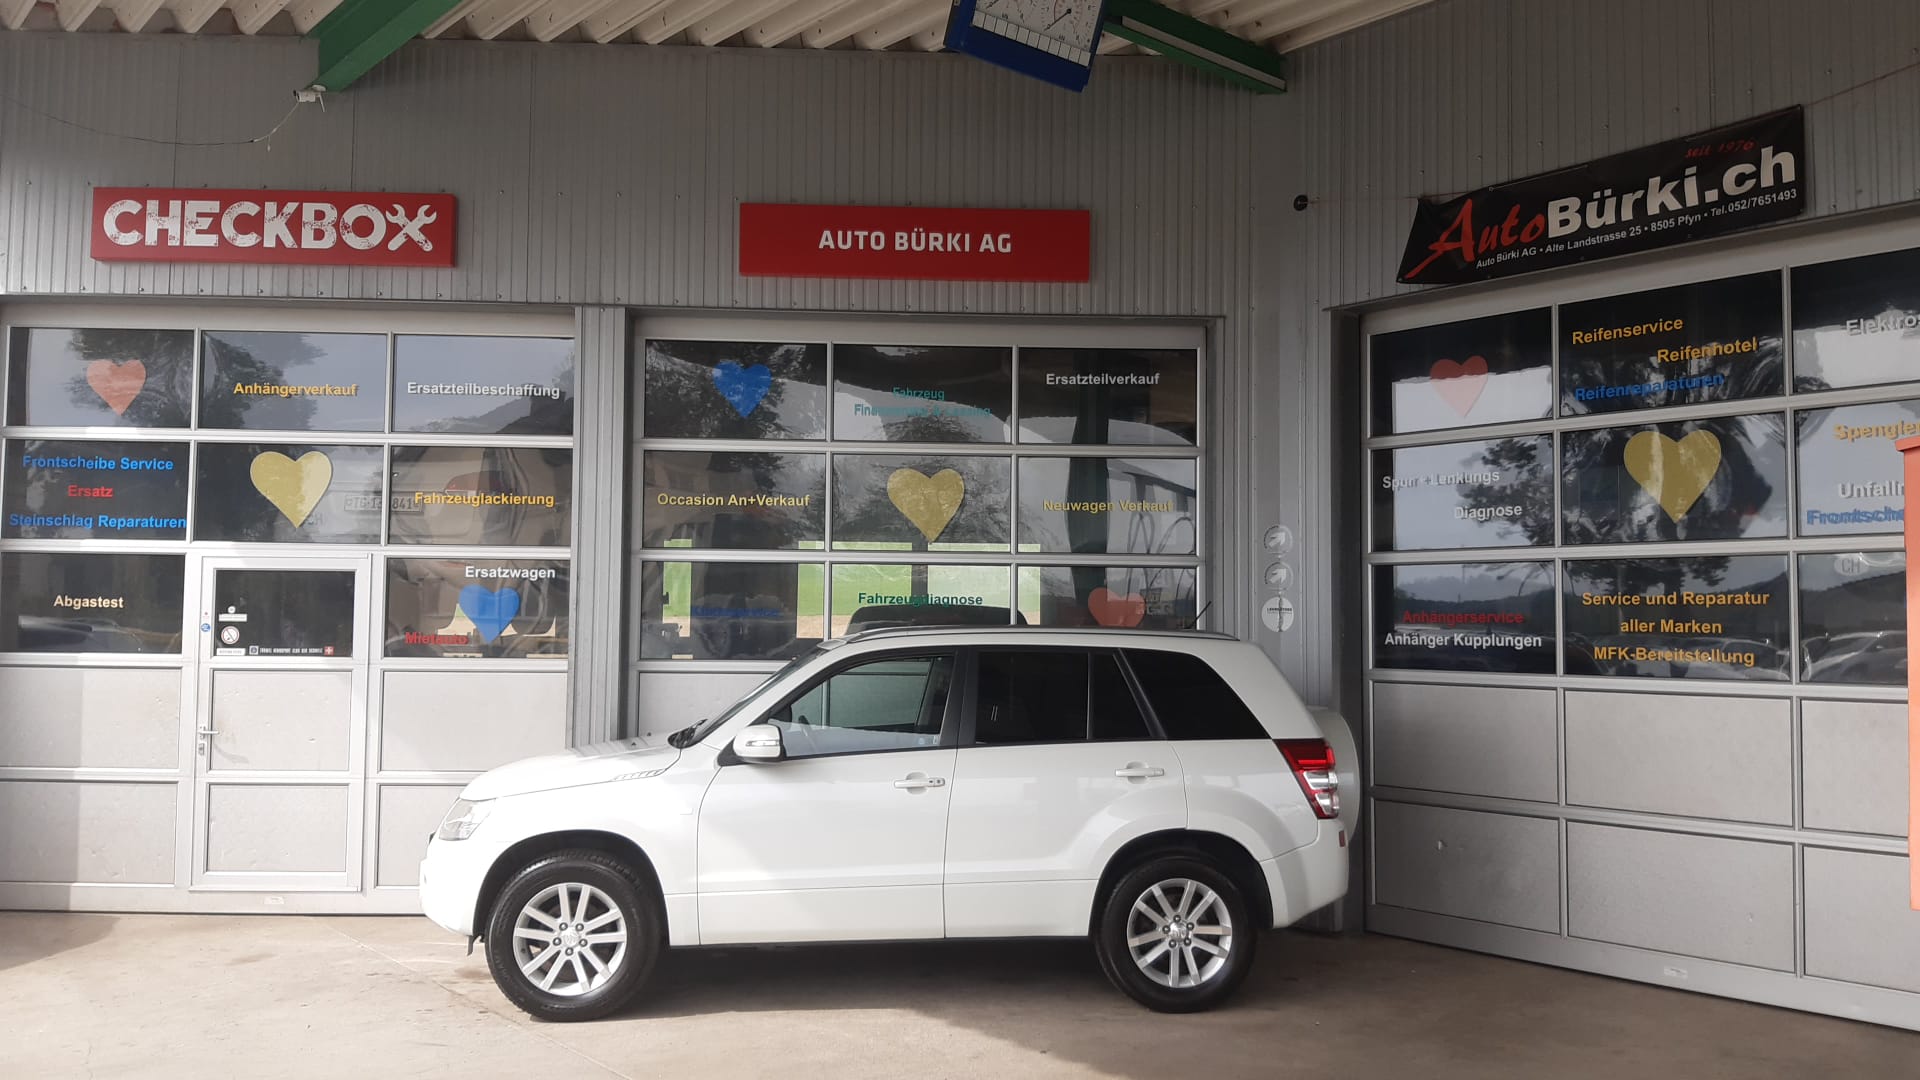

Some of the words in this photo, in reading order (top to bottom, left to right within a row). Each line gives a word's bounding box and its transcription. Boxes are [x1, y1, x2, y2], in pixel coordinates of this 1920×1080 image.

[818, 229, 885, 251] AUTO
[894, 227, 971, 253] BÜRKI
[979, 233, 1012, 254] AG
[1476, 257, 1495, 269] Auto
[1496, 249, 1520, 263] Bürki
[1521, 246, 1537, 258] AG
[1545, 243, 1565, 254] Alte
[1567, 230, 1627, 250] Landstrasse
[1629, 225, 1642, 237] 25
[1650, 219, 1675, 232] 8505
[1678, 213, 1701, 227] Pfyn
[1572, 318, 1684, 345] Reifenservice
[1657, 335, 1758, 363] Reifenhotel
[1046, 372, 1160, 385] Ersatzteilverkauf
[1575, 373, 1725, 401] Reifenreparaturen
[233, 382, 359, 398] Anhängerverkauf
[406, 381, 561, 400] Ersatzteilbeschaffung
[892, 386, 945, 401] Fahrzeug
[22, 455, 116, 470] Frontscheibe
[119, 457, 174, 471] Service
[1432, 470, 1500, 487] Lenkungs
[67, 484, 113, 498] Ersatz
[414, 491, 555, 508] Fahrzeuglackierung
[657, 493, 724, 506] Occasion
[727, 493, 811, 507] An+Verkauf
[1043, 499, 1115, 514] Neuwagen
[1118, 499, 1174, 512] Verkauf
[9, 513, 93, 529] Steinschlag
[98, 514, 187, 530] Reparaturen
[1454, 505, 1523, 521] Diagnose
[464, 565, 556, 581] Ersatzwagen
[53, 594, 124, 610] Abgastest
[858, 592, 983, 607] Fahrzeugdiagnose
[1582, 591, 1641, 606] Service
[1646, 591, 1677, 605] und
[1682, 590, 1769, 608] Reparatur
[1402, 610, 1524, 627] Anhängerservice
[1620, 618, 1656, 633] aller
[1660, 618, 1722, 634] Marken
[1384, 632, 1450, 649] Anhänger
[1453, 633, 1542, 650] Kupplungen
[1594, 646, 1755, 668] MFK-Bereitstellung
